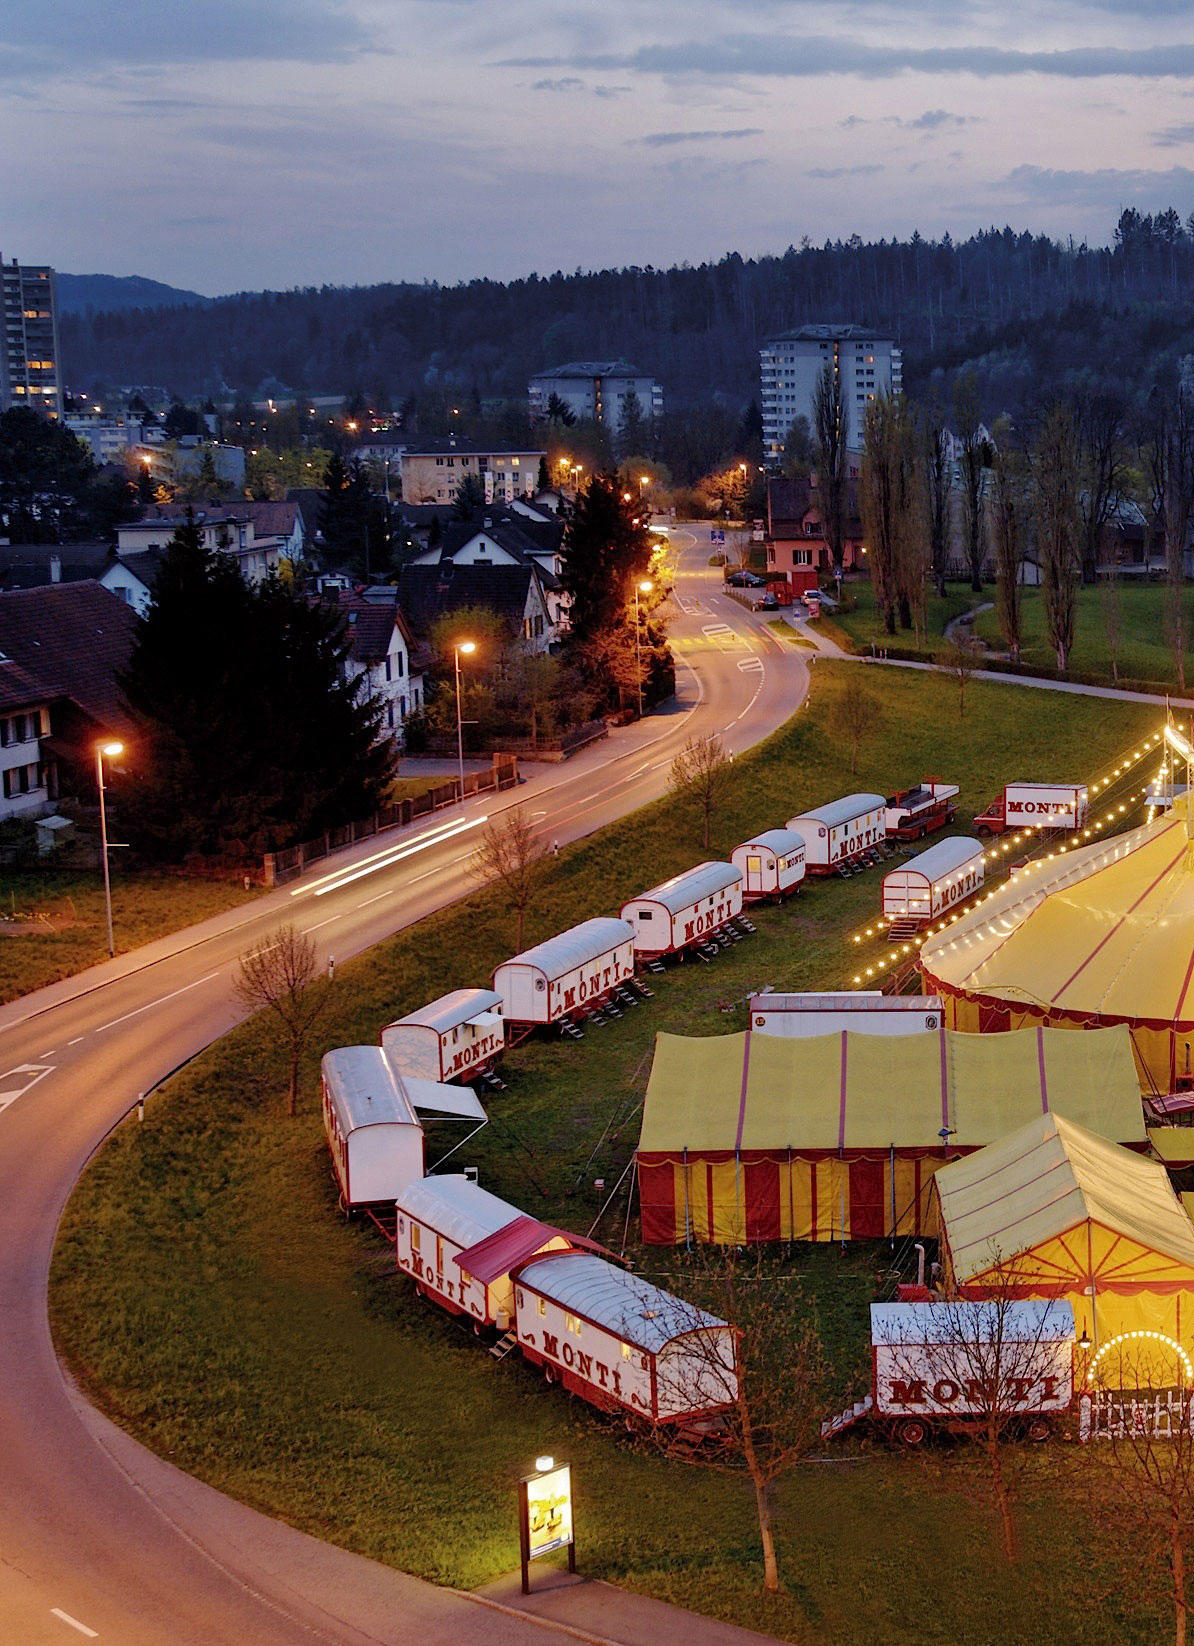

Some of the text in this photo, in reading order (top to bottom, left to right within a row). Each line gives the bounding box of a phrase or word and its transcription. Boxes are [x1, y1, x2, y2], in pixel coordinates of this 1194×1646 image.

[1008, 801, 1073, 815] MONTI
[787, 852, 805, 869] MONTI
[840, 827, 877, 858] MONTI
[941, 871, 976, 907] MONTI
[685, 900, 732, 941] MONTI
[564, 962, 620, 1011] MONTI
[453, 1034, 495, 1072] MONTI
[411, 1253, 467, 1305] MONTI
[543, 1331, 621, 1395] MONTI
[889, 1375, 1059, 1404] MONTI
